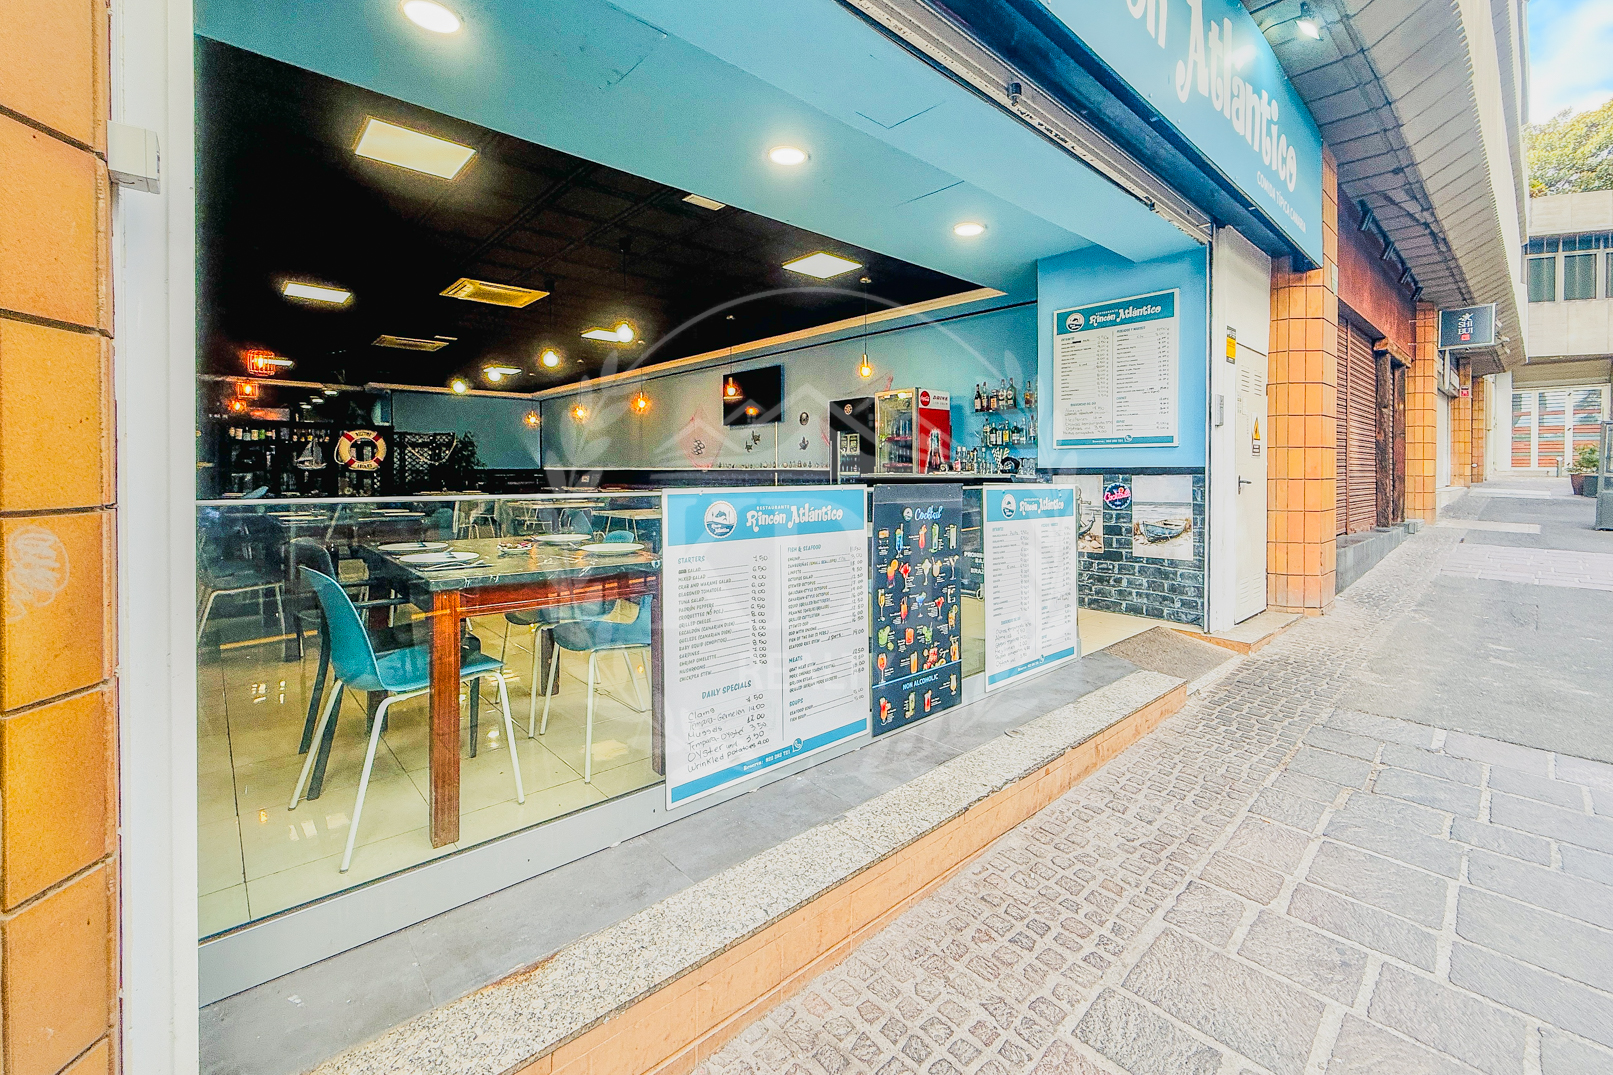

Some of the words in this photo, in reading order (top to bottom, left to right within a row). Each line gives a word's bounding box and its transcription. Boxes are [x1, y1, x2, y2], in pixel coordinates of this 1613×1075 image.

[1089, 313, 1115, 327] Rincón
[1116, 304, 1162, 323] Atlántico
[1019, 500, 1038, 516] Rincón
[1038, 496, 1064, 514] Atlántico
[745, 509, 787, 533] Rincón
[787, 503, 844, 529] Atlántico
[803, 544, 822, 552] SEAFOOD
[677, 555, 706, 565] STARTERS
[788, 655, 803, 664] MEATS
[702, 687, 721, 700] DAILY
[722, 679, 752, 694] SPECIALS
[902, 682, 913, 691] NON
[913, 673, 939, 687] ALCOHOLIC
[789, 697, 804, 707] SOUPS
